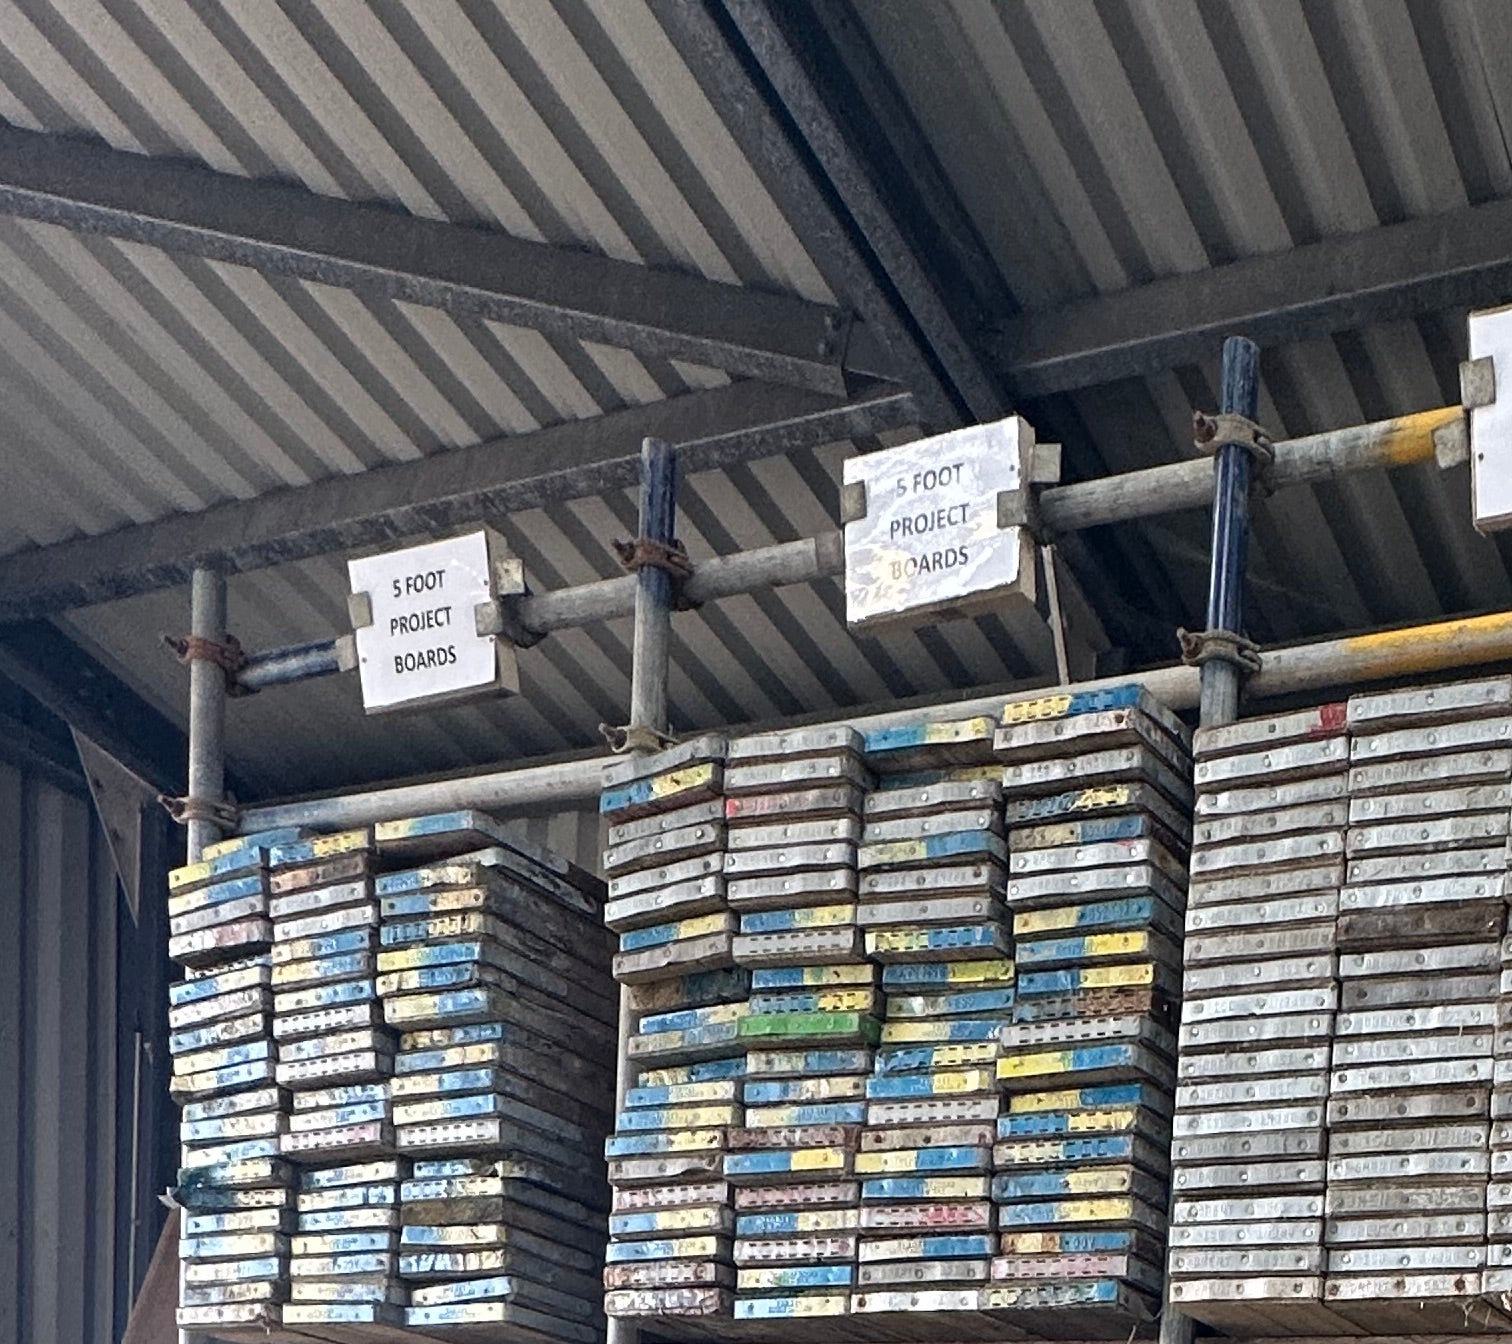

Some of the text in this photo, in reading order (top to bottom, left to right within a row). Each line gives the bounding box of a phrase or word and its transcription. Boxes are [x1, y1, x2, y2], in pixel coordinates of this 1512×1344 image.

[896, 462, 965, 498] 5 FOOT
[890, 502, 971, 541] PROJECT
[889, 544, 969, 580] BOARDS
[392, 569, 446, 599] 5 FOOT
[390, 606, 452, 637] PROJECT
[394, 645, 457, 674] BOARDS
